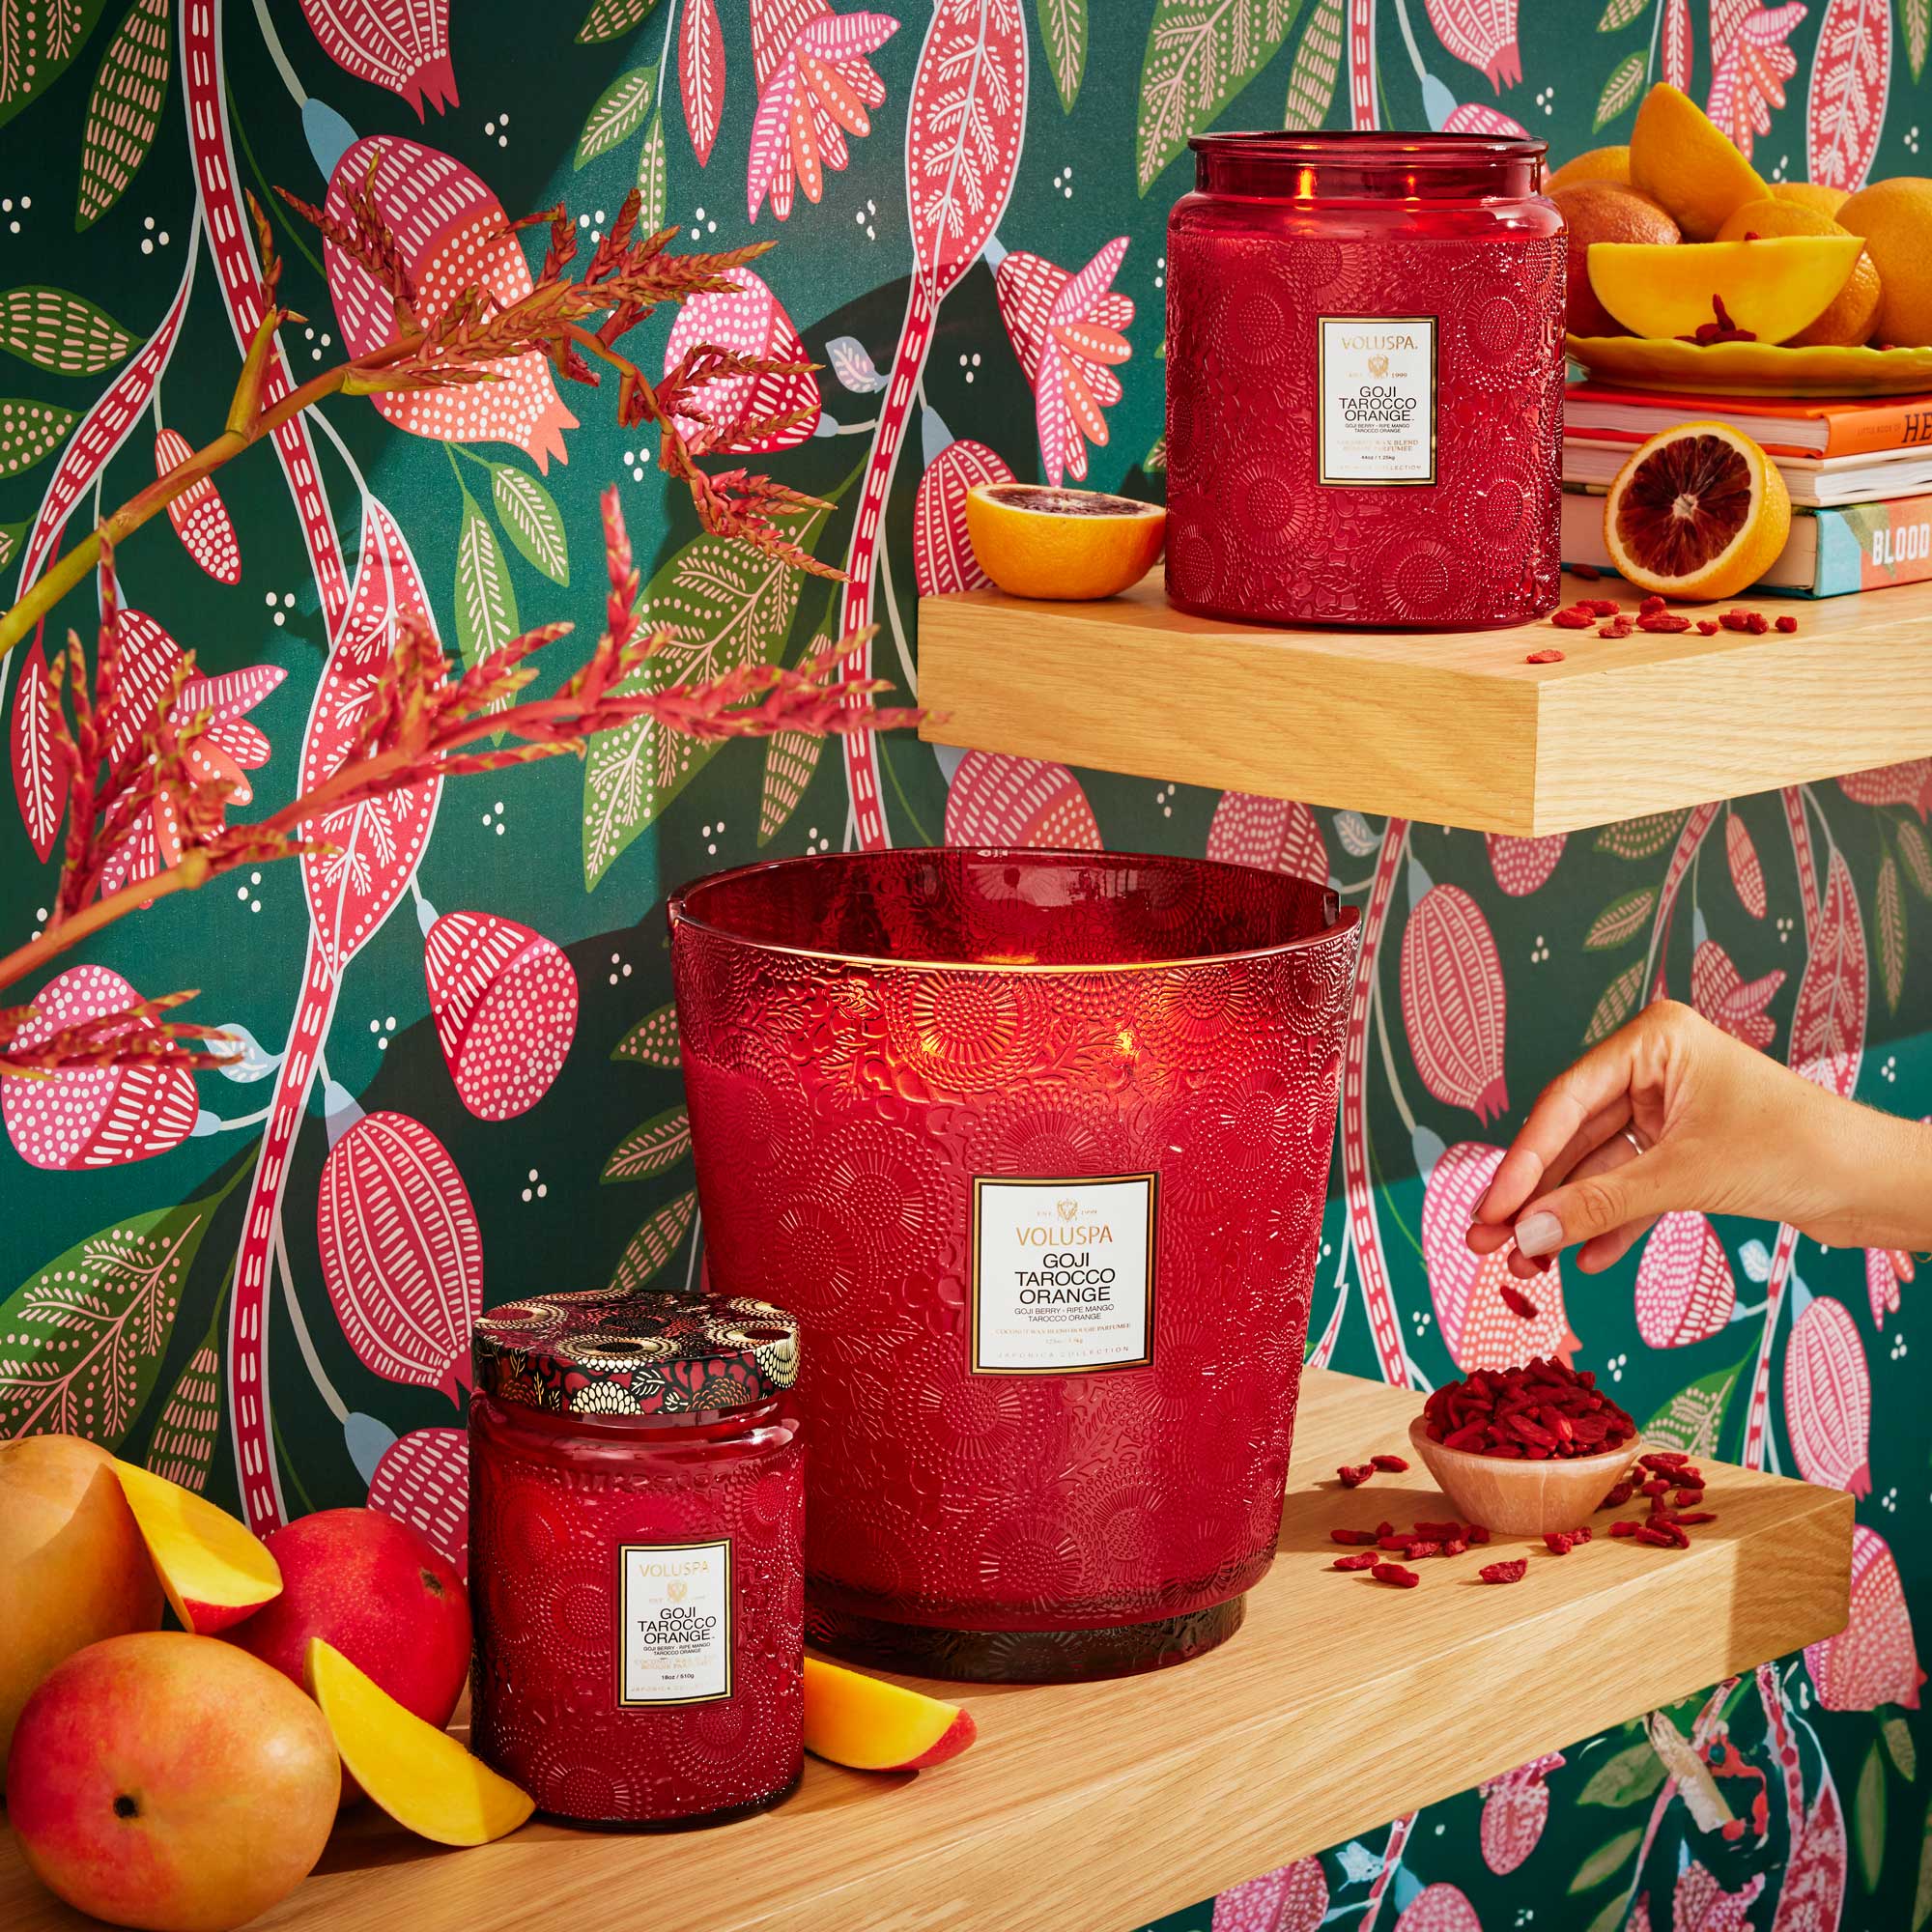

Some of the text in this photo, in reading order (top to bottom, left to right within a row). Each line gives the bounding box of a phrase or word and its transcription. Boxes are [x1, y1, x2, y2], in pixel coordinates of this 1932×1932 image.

[1359, 385, 1397, 397] GOJI
[1339, 397, 1417, 410] TAROCCO
[1872, 523, 1930, 566] BLOOD
[1015, 1224, 1113, 1246] VOLUSPA
[1042, 1252, 1090, 1268] GOJI
[1014, 1267, 1116, 1287] TAROCCO
[1019, 1286, 1111, 1305] ORANGE
[1085, 1303, 1114, 1313] MANGO
[1067, 1312, 1101, 1321] ORANGE
[639, 1560, 710, 1577] VOLUSPA
[660, 1606, 696, 1620] GOJI
[637, 1615, 717, 1633] TAROCCO
